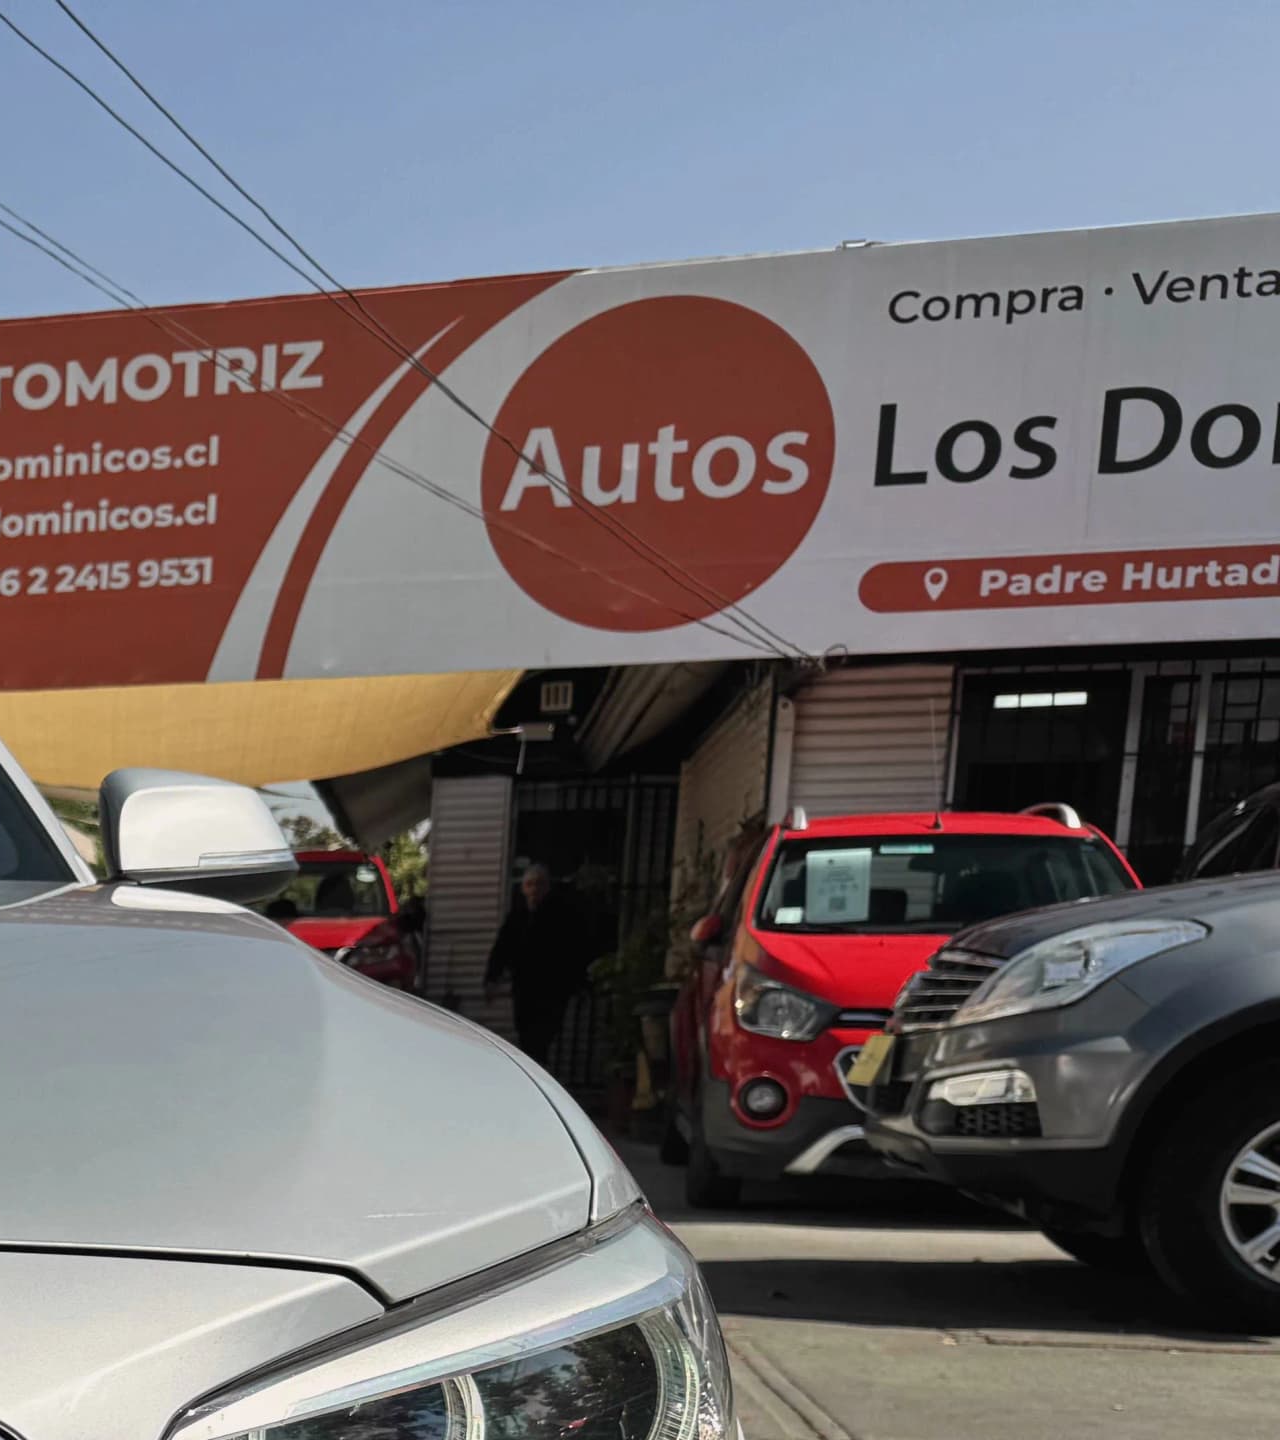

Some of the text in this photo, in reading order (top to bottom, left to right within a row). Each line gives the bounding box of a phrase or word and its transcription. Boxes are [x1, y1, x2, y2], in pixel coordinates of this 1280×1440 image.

[888, 284, 1084, 325] Compra
[1132, 265, 1280, 306] Venta
[500, 423, 811, 511] Autos
[873, 386, 1280, 488] Los Do
[27, 567, 49, 595] 2
[54, 561, 131, 594] 2415
[137, 555, 214, 588] 9531
[979, 554, 1280, 597] Padre Hurtad
